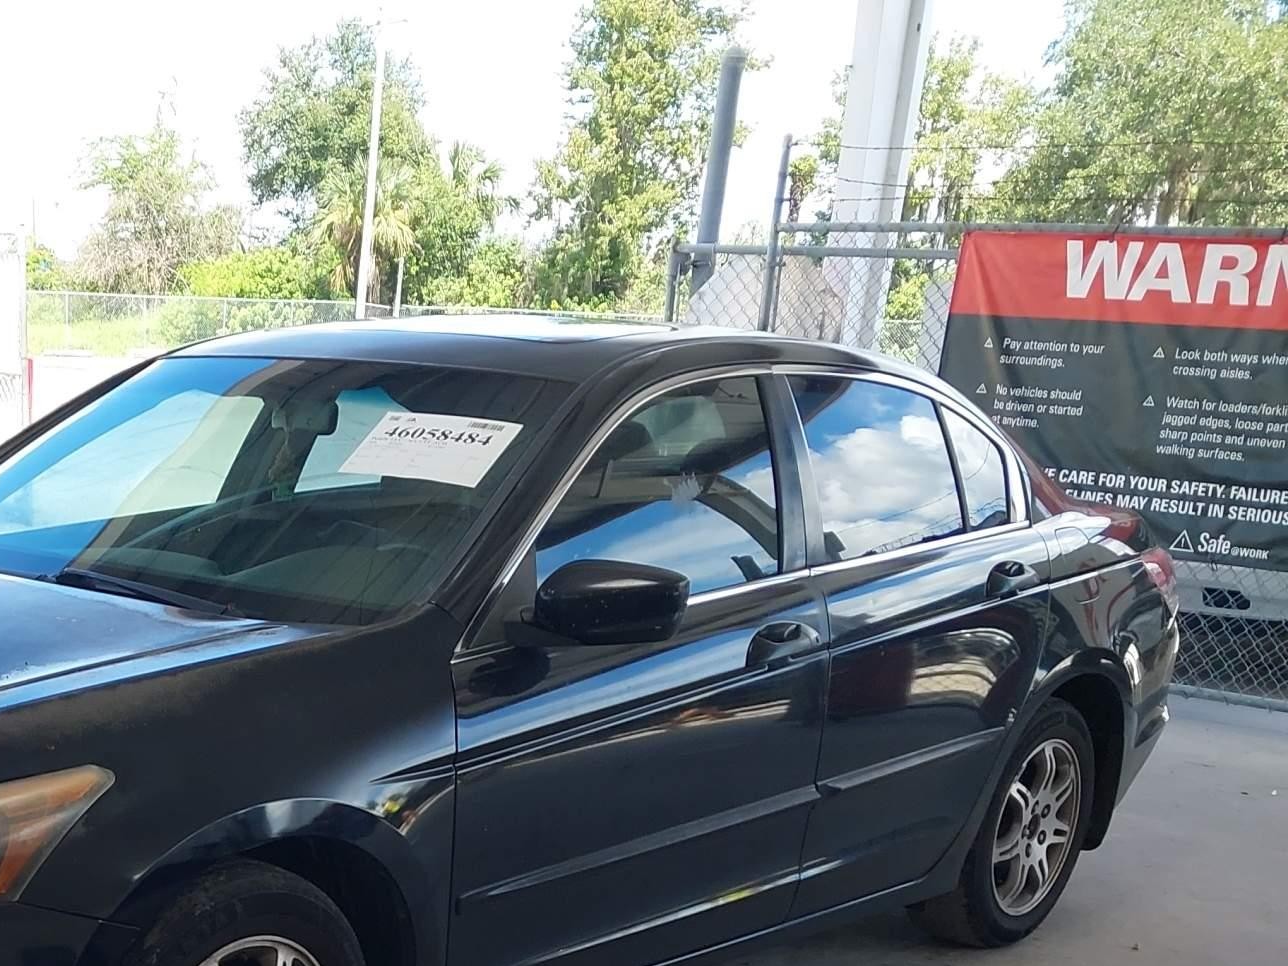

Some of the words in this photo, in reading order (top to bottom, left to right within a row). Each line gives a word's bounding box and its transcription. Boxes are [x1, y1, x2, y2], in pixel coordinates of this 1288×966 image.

[1002, 338, 1022, 350] Pay
[1024, 339, 1067, 352] attention
[1070, 342, 1080, 352] to
[1082, 344, 1105, 356] your
[1000, 354, 1065, 368] surroundings.
[1175, 348, 1201, 360] Look
[1204, 349, 1228, 362] both
[1230, 352, 1258, 365] ways
[1172, 365, 1217, 380] crossing
[1220, 368, 1253, 380] aisles.
[996, 384, 1008, 395] No
[1010, 385, 1048, 398] vehicles
[1050, 388, 1082, 400] should
[994, 399, 1005, 410] be
[1006, 400, 1034, 412] driven
[1036, 404, 1047, 413] or
[1048, 405, 1084, 416] started
[1166, 396, 1200, 410] Watch
[1202, 398, 1217, 411] for
[992, 414, 1001, 424] at
[1002, 416, 1039, 428] anytime.
[1162, 412, 1198, 426] jagged
[1199, 415, 1232, 430] edges,
[1234, 418, 1264, 430] loose
[384, 426, 494, 446] 46058484
[1159, 428, 1188, 442] sharp
[1190, 430, 1223, 444] points
[1224, 433, 1244, 446] and
[1247, 438, 1286, 449] uneven
[1156, 444, 1195, 459] walking
[1197, 448, 1245, 462] surfaces.
[1044, 467, 1056, 481] E
[1058, 469, 1096, 486] CARE
[1098, 472, 1126, 489] FOR
[1128, 476, 1167, 492] YOUR
[1170, 480, 1226, 499] SAFETY.
[1230, 486, 1288, 505] FAILURE
[1065, 488, 1113, 505] ELINES
[1116, 494, 1148, 510] MAY
[1150, 498, 1206, 516] RESULT
[1208, 502, 1225, 518] IN
[1228, 505, 1288, 526] SERIOUS
